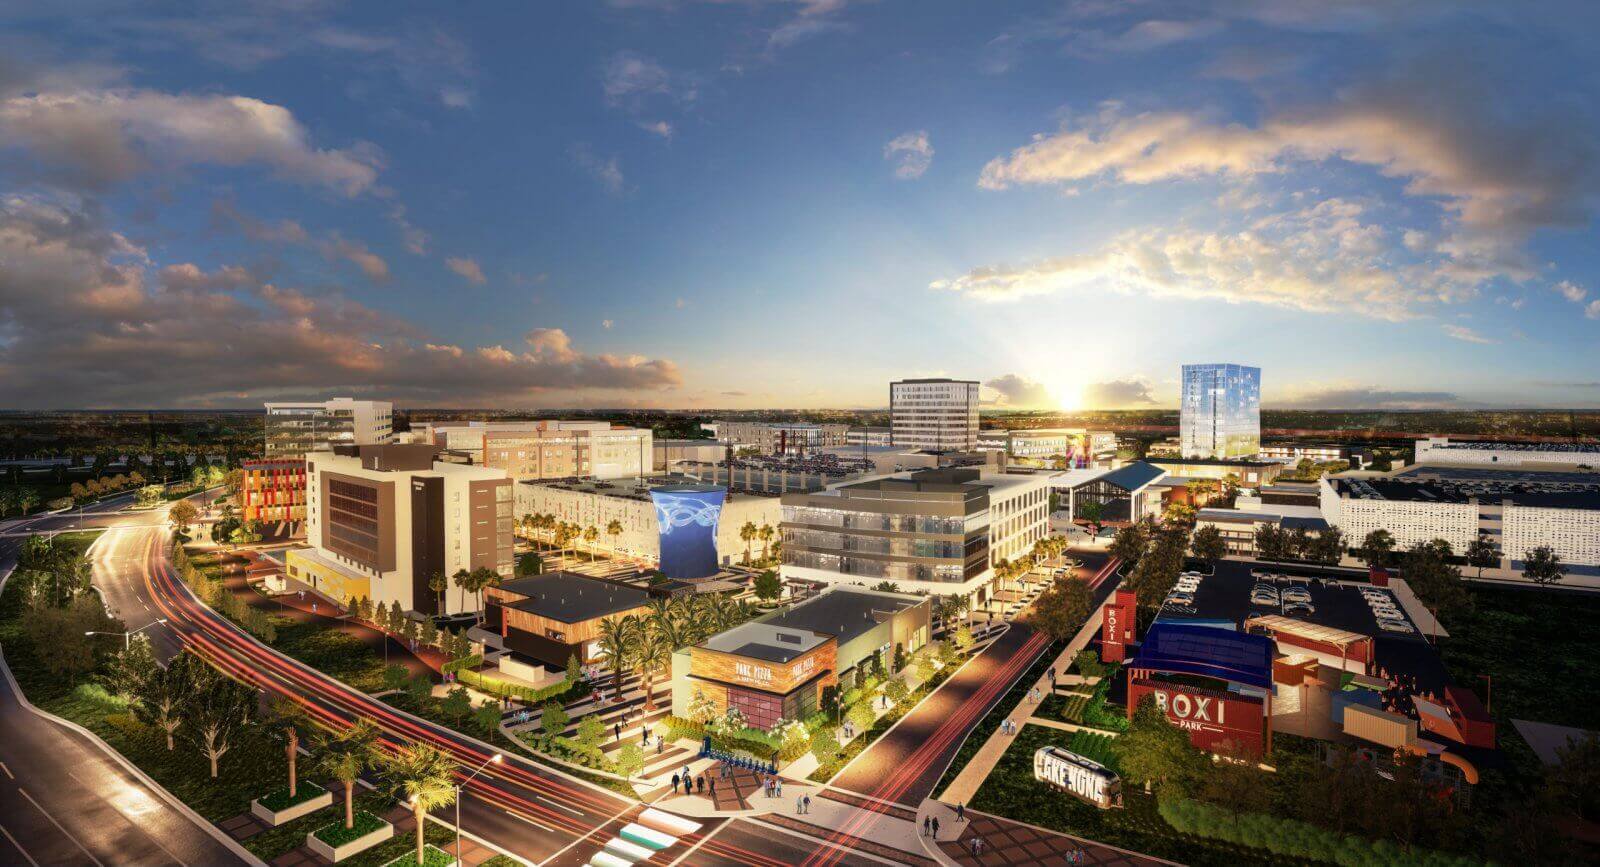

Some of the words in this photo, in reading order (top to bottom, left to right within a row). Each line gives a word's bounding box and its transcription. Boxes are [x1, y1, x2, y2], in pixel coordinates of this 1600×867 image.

[1108, 609, 1117, 641] BOXI
[1155, 690, 1225, 724] BOXI
[1180, 721, 1202, 731] PARK
[1036, 753, 1068, 788] LAKE
